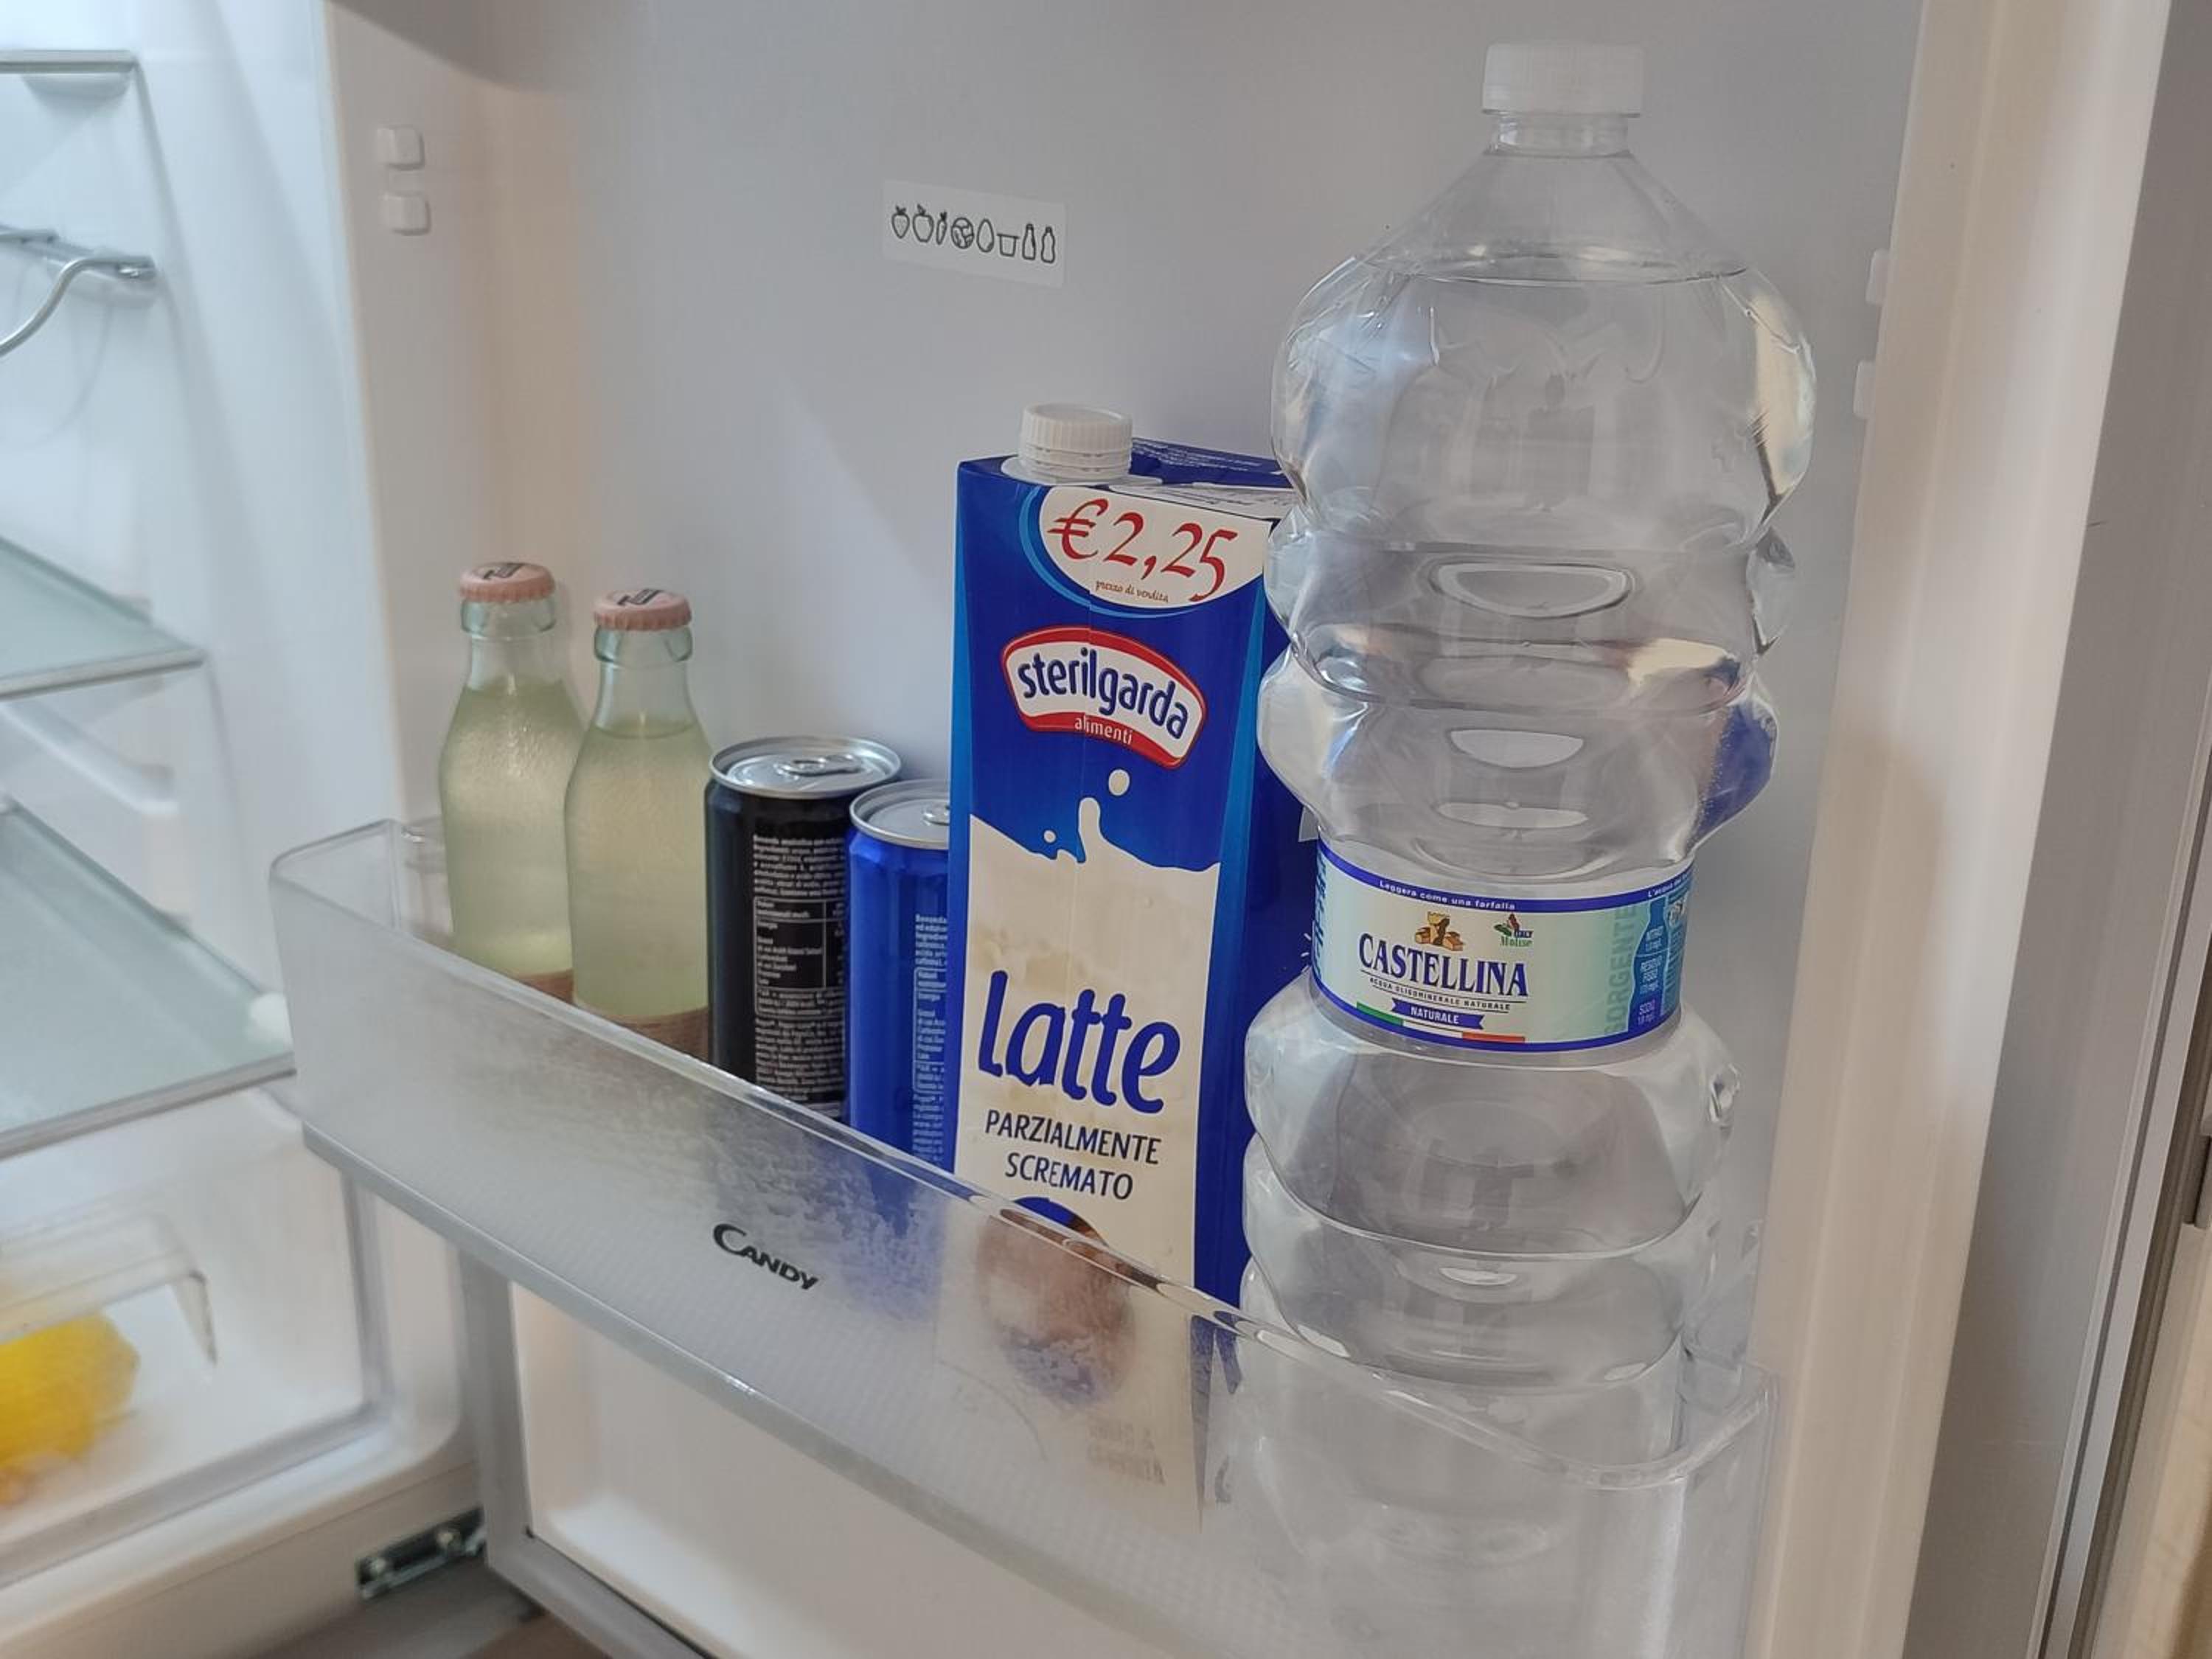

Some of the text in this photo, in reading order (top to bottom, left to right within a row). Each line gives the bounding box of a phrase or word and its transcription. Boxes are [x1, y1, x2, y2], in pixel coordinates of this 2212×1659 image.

[1096, 580, 1169, 603] prezzo di vendita
[1018, 647, 1189, 740] sterilgarda
[1074, 716, 1133, 745] alimenti
[1380, 880, 1515, 911] Leggera come una farfalla
[1359, 932, 1528, 997] CASTELLINA
[1370, 977, 1511, 1011] ACQUA OLIGOMINERALE NATURALE
[1411, 1006, 1460, 1025] NATURALE
[985, 1109, 1162, 1165] PARZIALMENTE
[1005, 1152, 1134, 1200] SCREMATO
